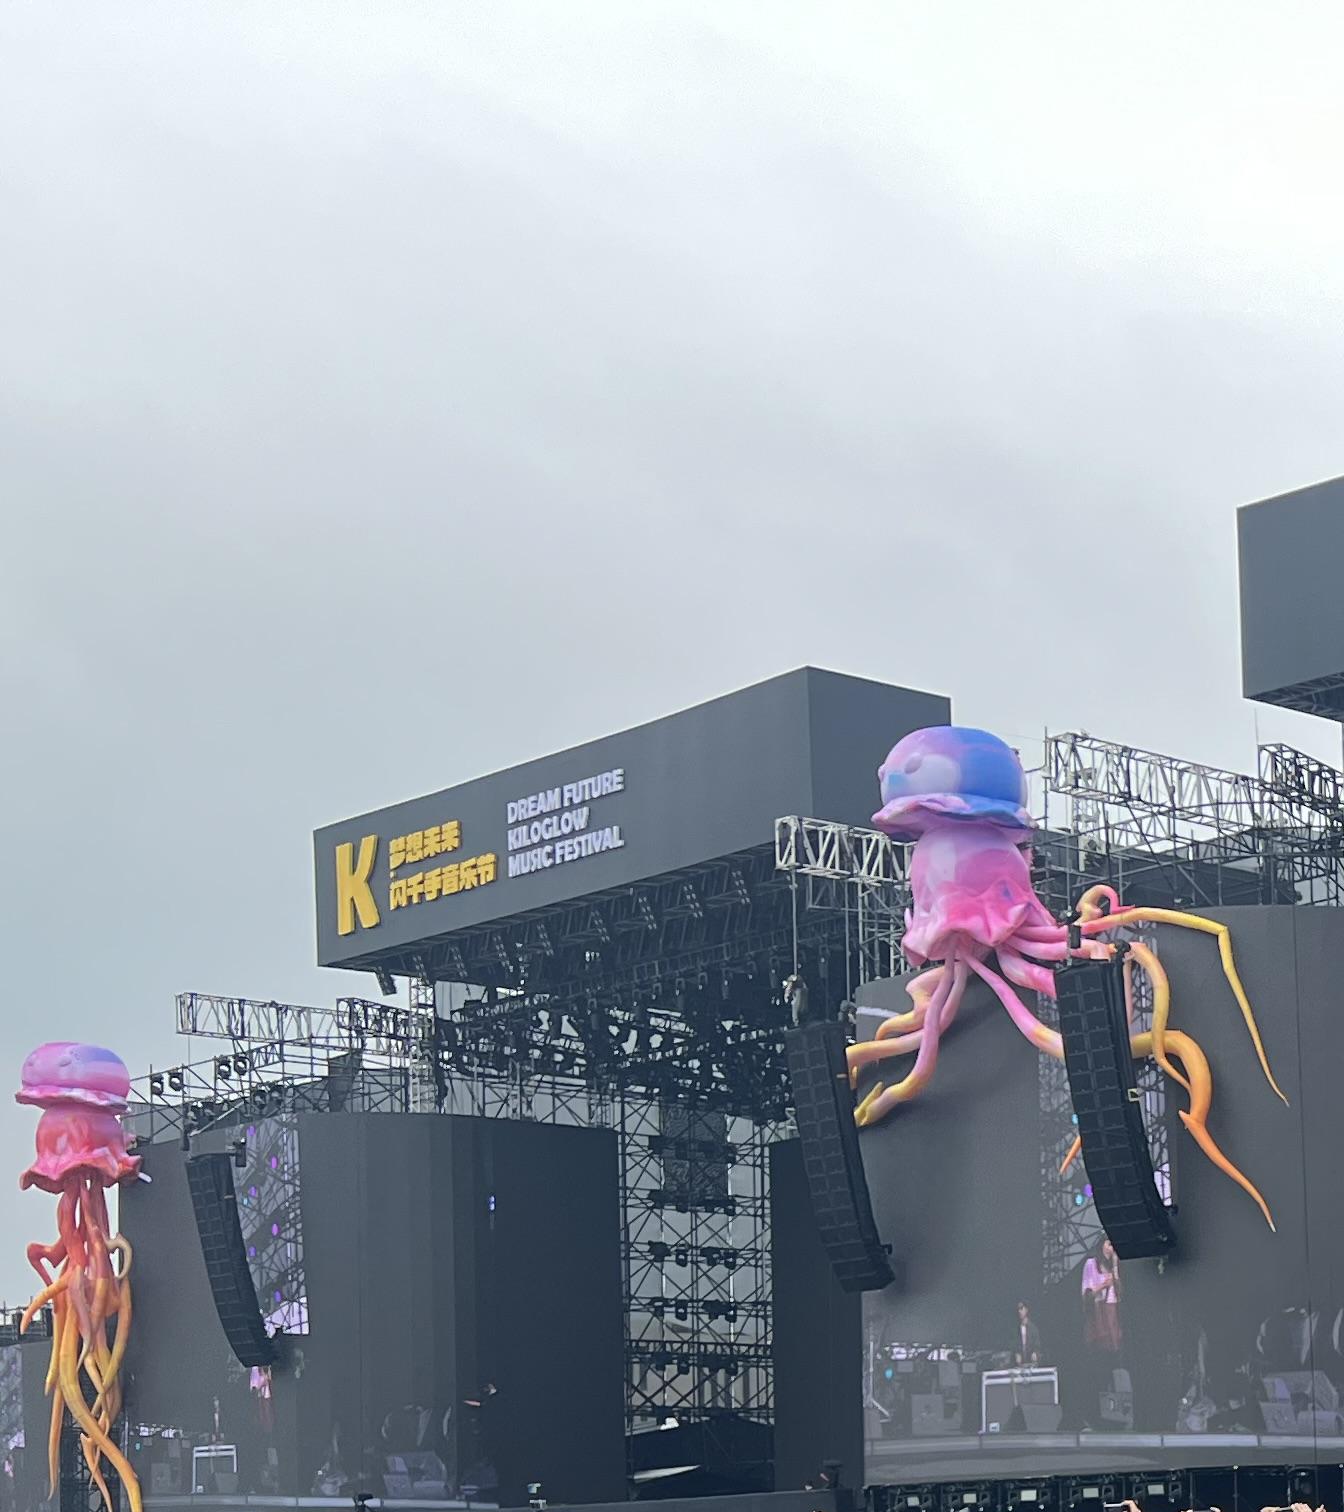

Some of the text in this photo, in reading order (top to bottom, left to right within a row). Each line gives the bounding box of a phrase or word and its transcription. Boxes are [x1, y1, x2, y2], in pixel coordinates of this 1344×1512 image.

[506, 768, 625, 825] DREAM FUTURE
[389, 819, 460, 869] 梦想未来
[507, 806, 590, 852] KILOGLOW
[507, 825, 625, 878] MUSIC FESTIVAL
[336, 834, 381, 937] K
